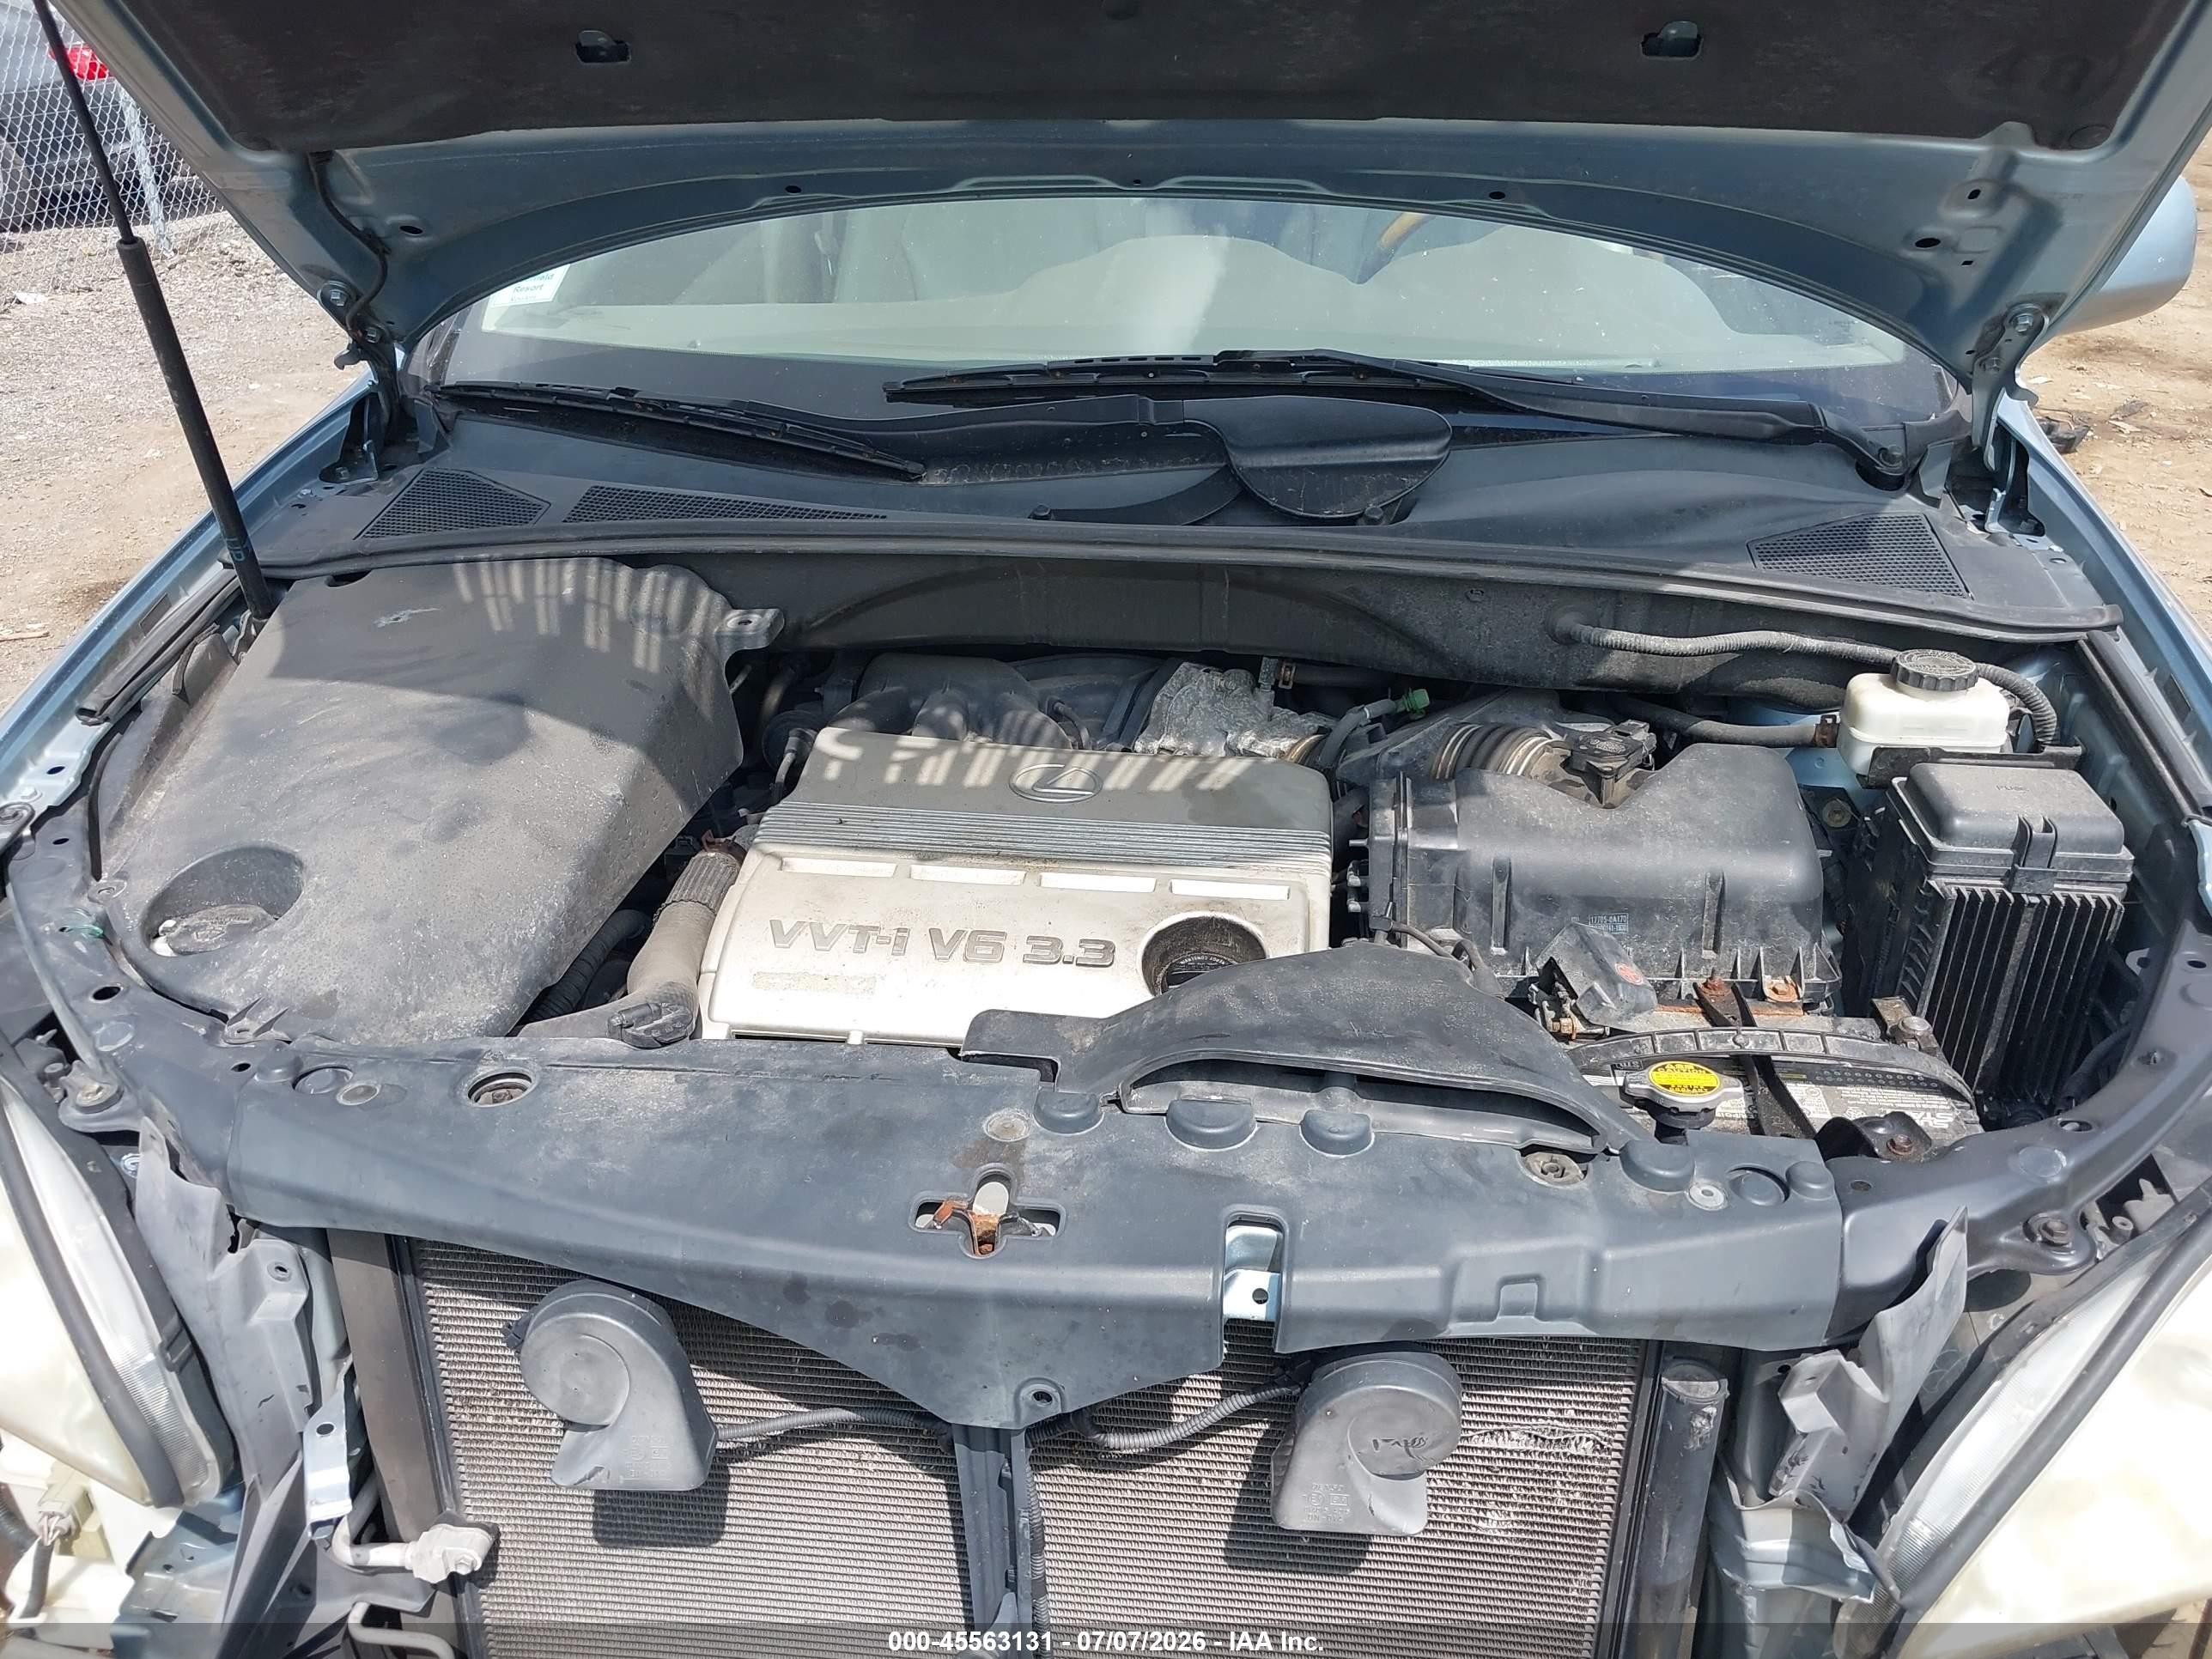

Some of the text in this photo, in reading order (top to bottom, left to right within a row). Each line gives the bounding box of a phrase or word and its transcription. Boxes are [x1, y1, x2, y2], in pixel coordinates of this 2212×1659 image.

[513, 284, 544, 294] Resort
[928, 927, 1007, 963] V6
[1022, 934, 1116, 968] 3.3
